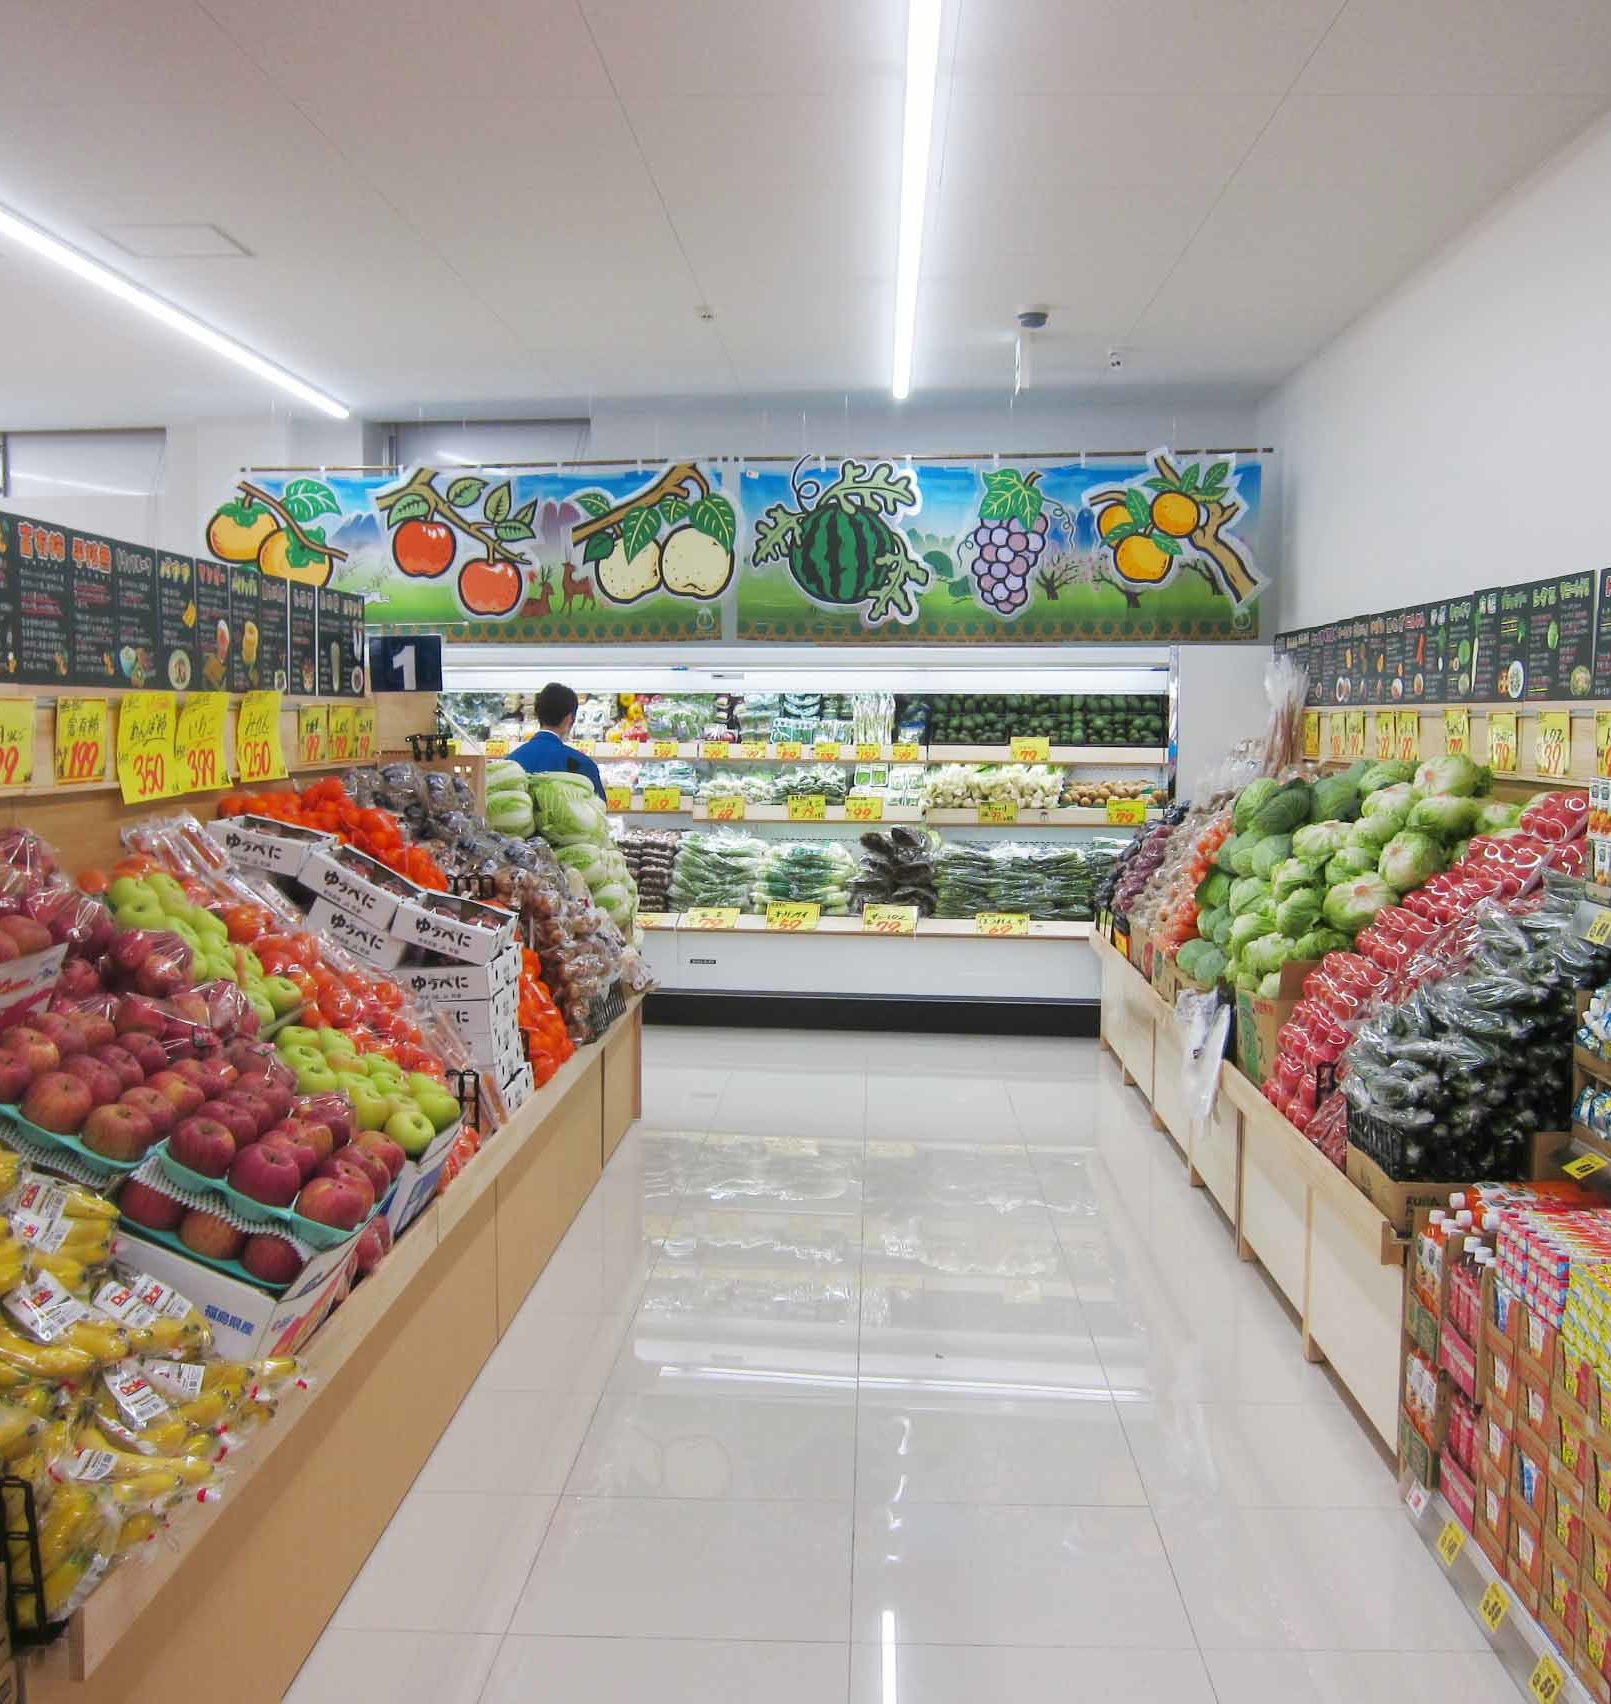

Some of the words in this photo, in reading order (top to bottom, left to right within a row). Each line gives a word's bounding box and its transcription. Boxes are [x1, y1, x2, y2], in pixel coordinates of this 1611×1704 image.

[392, 645, 417, 691] 1
[69, 740, 99, 779] 199
[187, 748, 216, 789] 399
[244, 740, 271, 778] 250
[1020, 750, 1038, 761] 79
[133, 753, 165, 796] 350
[853, 807, 872, 817] 99
[225, 833, 283, 860] ゆうべに
[324, 869, 377, 910] ゆうべに
[330, 913, 385, 950] ゆうべに
[415, 917, 472, 948] ゆうべに
[411, 975, 469, 992] ゆうべに
